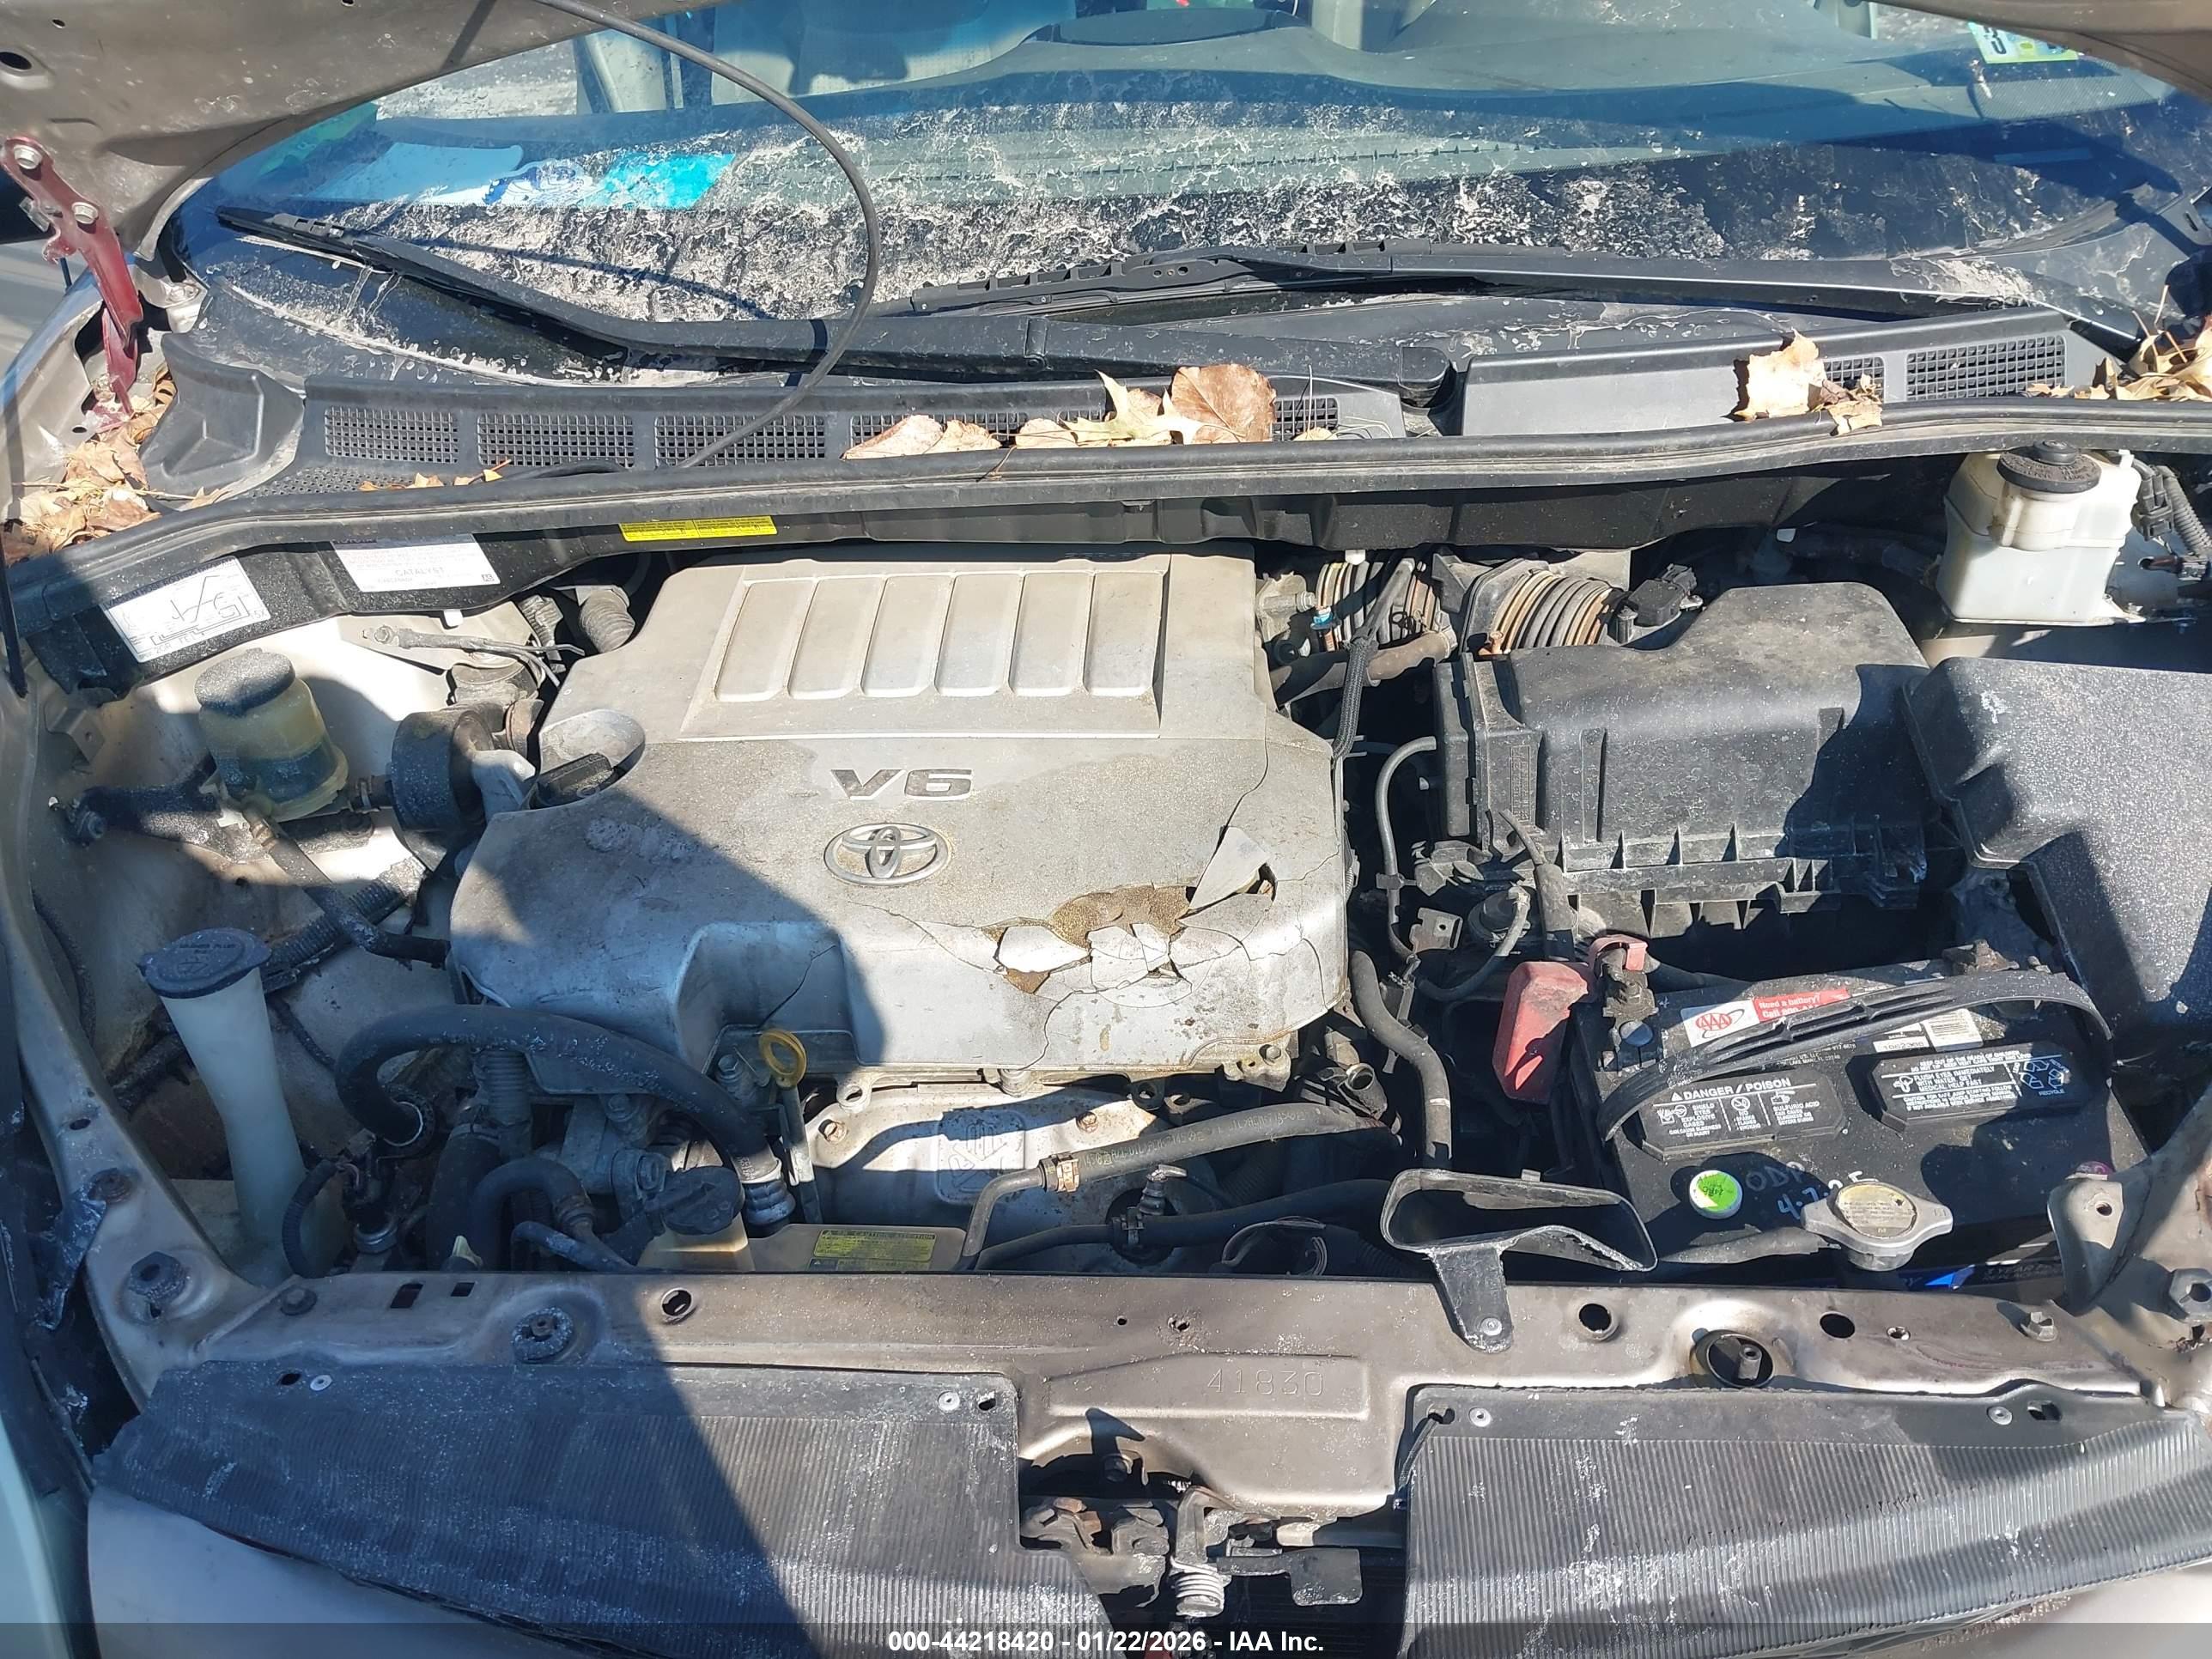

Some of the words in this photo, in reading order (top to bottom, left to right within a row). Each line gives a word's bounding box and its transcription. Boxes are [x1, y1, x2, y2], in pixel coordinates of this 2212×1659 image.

[830, 769, 973, 800] V6
[1759, 1000, 1780, 1009] Need
[1788, 993, 1820, 1006] battery?
[1696, 1012, 1733, 1030] AAA
[1763, 1009, 1780, 1019] Call
[1913, 1072, 1935, 1081] FLUSH
[1936, 1070, 1953, 1079] EYES
[1953, 1066, 1995, 1077] IMMEDIATELY
[1683, 1085, 1734, 1100] DANGER
[1744, 1077, 1792, 1091] POISON
[1918, 1084, 1947, 1092] MEDICAL
[1948, 1081, 1966, 1090] HELP
[2039, 1088, 2065, 1097] RECYCLE
[1772, 1103, 1804, 1112] SULFURIC
[1206, 1368, 1323, 1395] 41830
